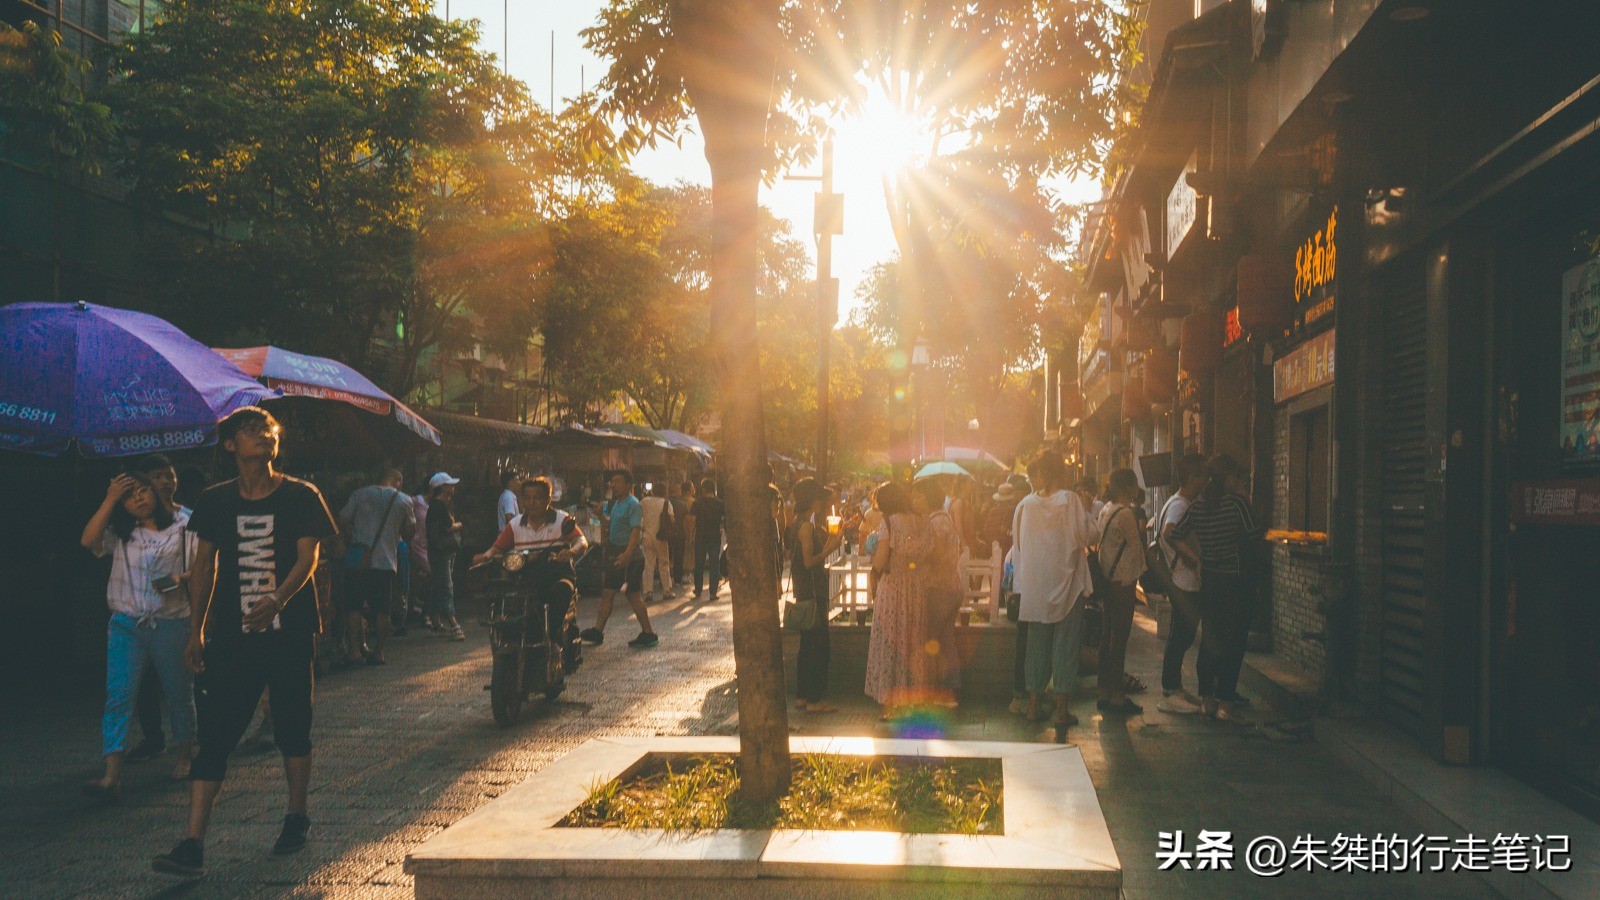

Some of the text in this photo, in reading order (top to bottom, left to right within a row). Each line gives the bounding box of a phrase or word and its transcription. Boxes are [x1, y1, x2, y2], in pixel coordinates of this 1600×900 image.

[19, 406, 56, 425] 8811
[119, 434, 161, 450] 8886
[163, 430, 205, 446] 8886
